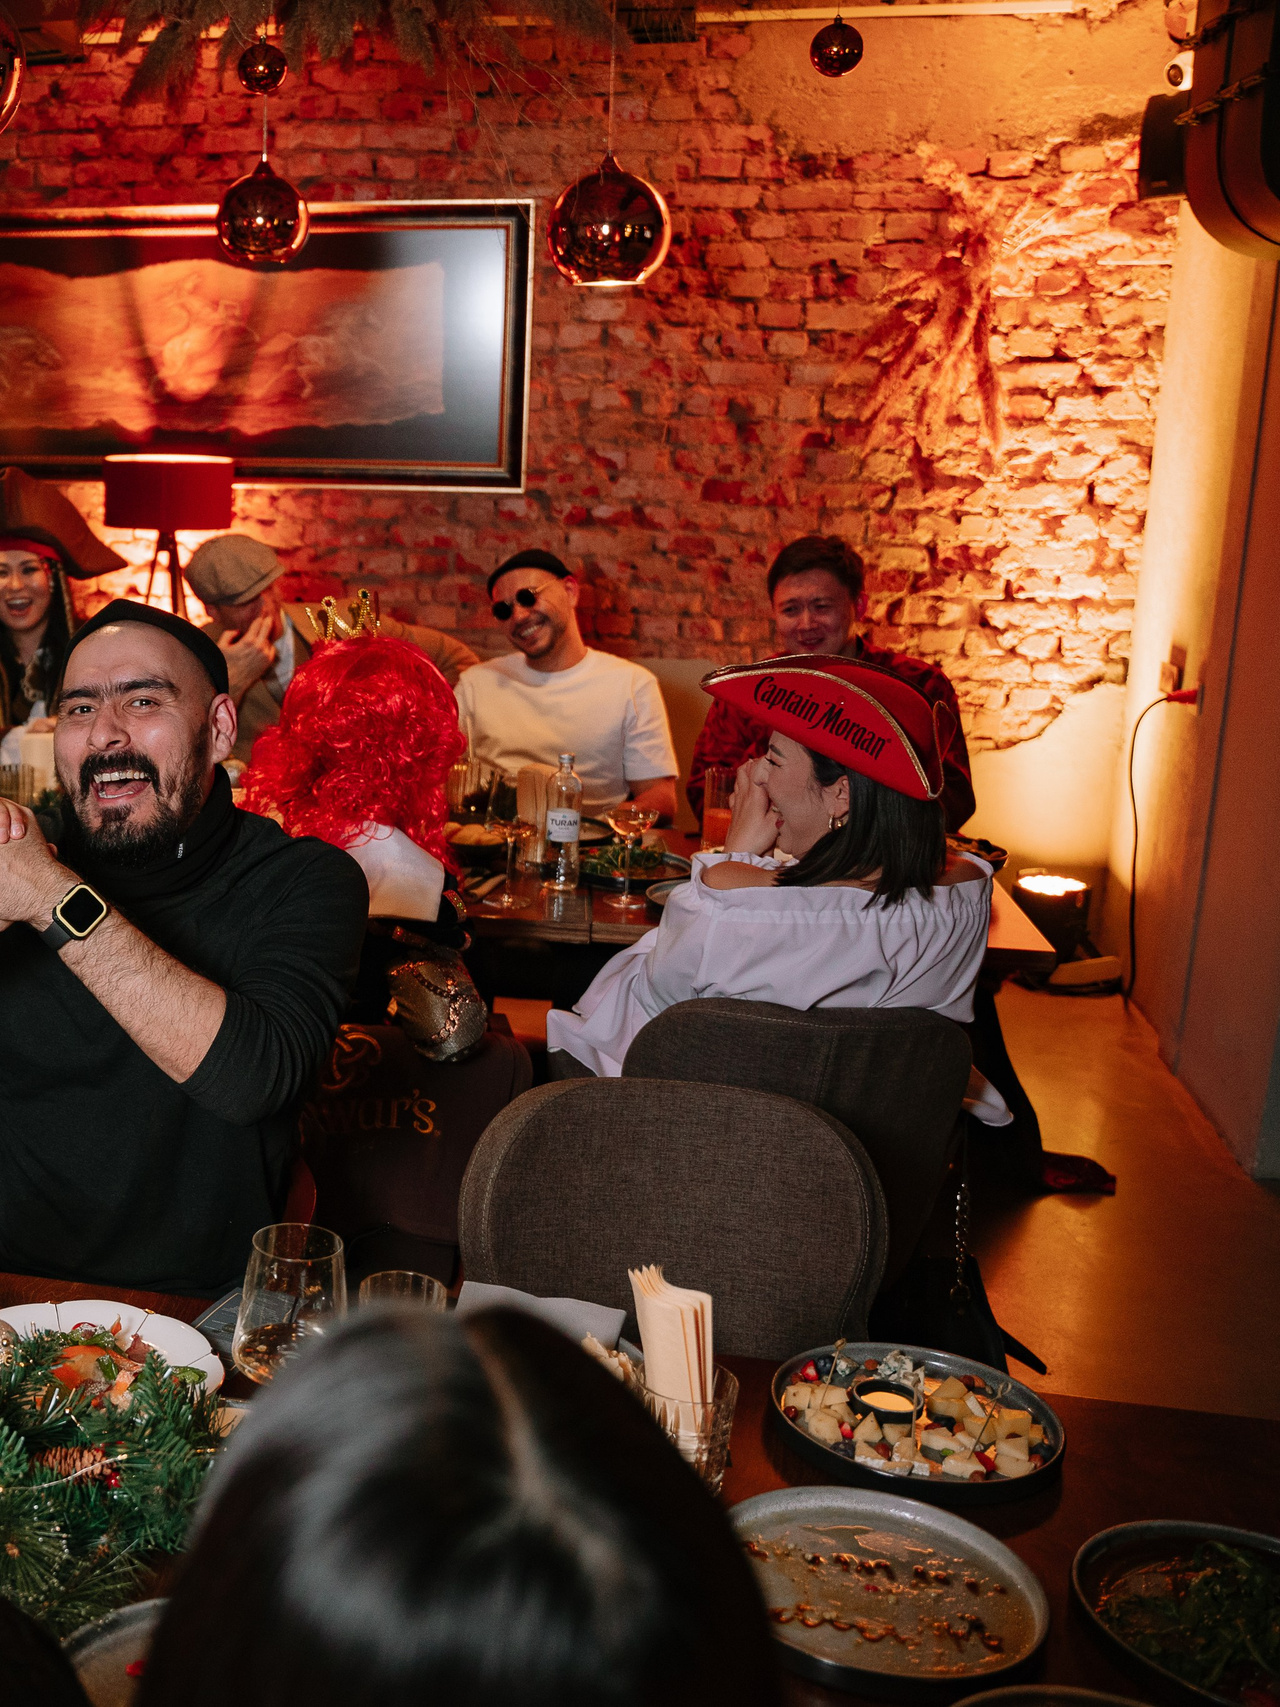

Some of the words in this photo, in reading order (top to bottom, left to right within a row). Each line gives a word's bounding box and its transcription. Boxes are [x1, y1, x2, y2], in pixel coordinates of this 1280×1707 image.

[754, 676, 820, 722] Captain
[807, 701, 888, 760] Morgan
[550, 818, 578, 826] TURAN
